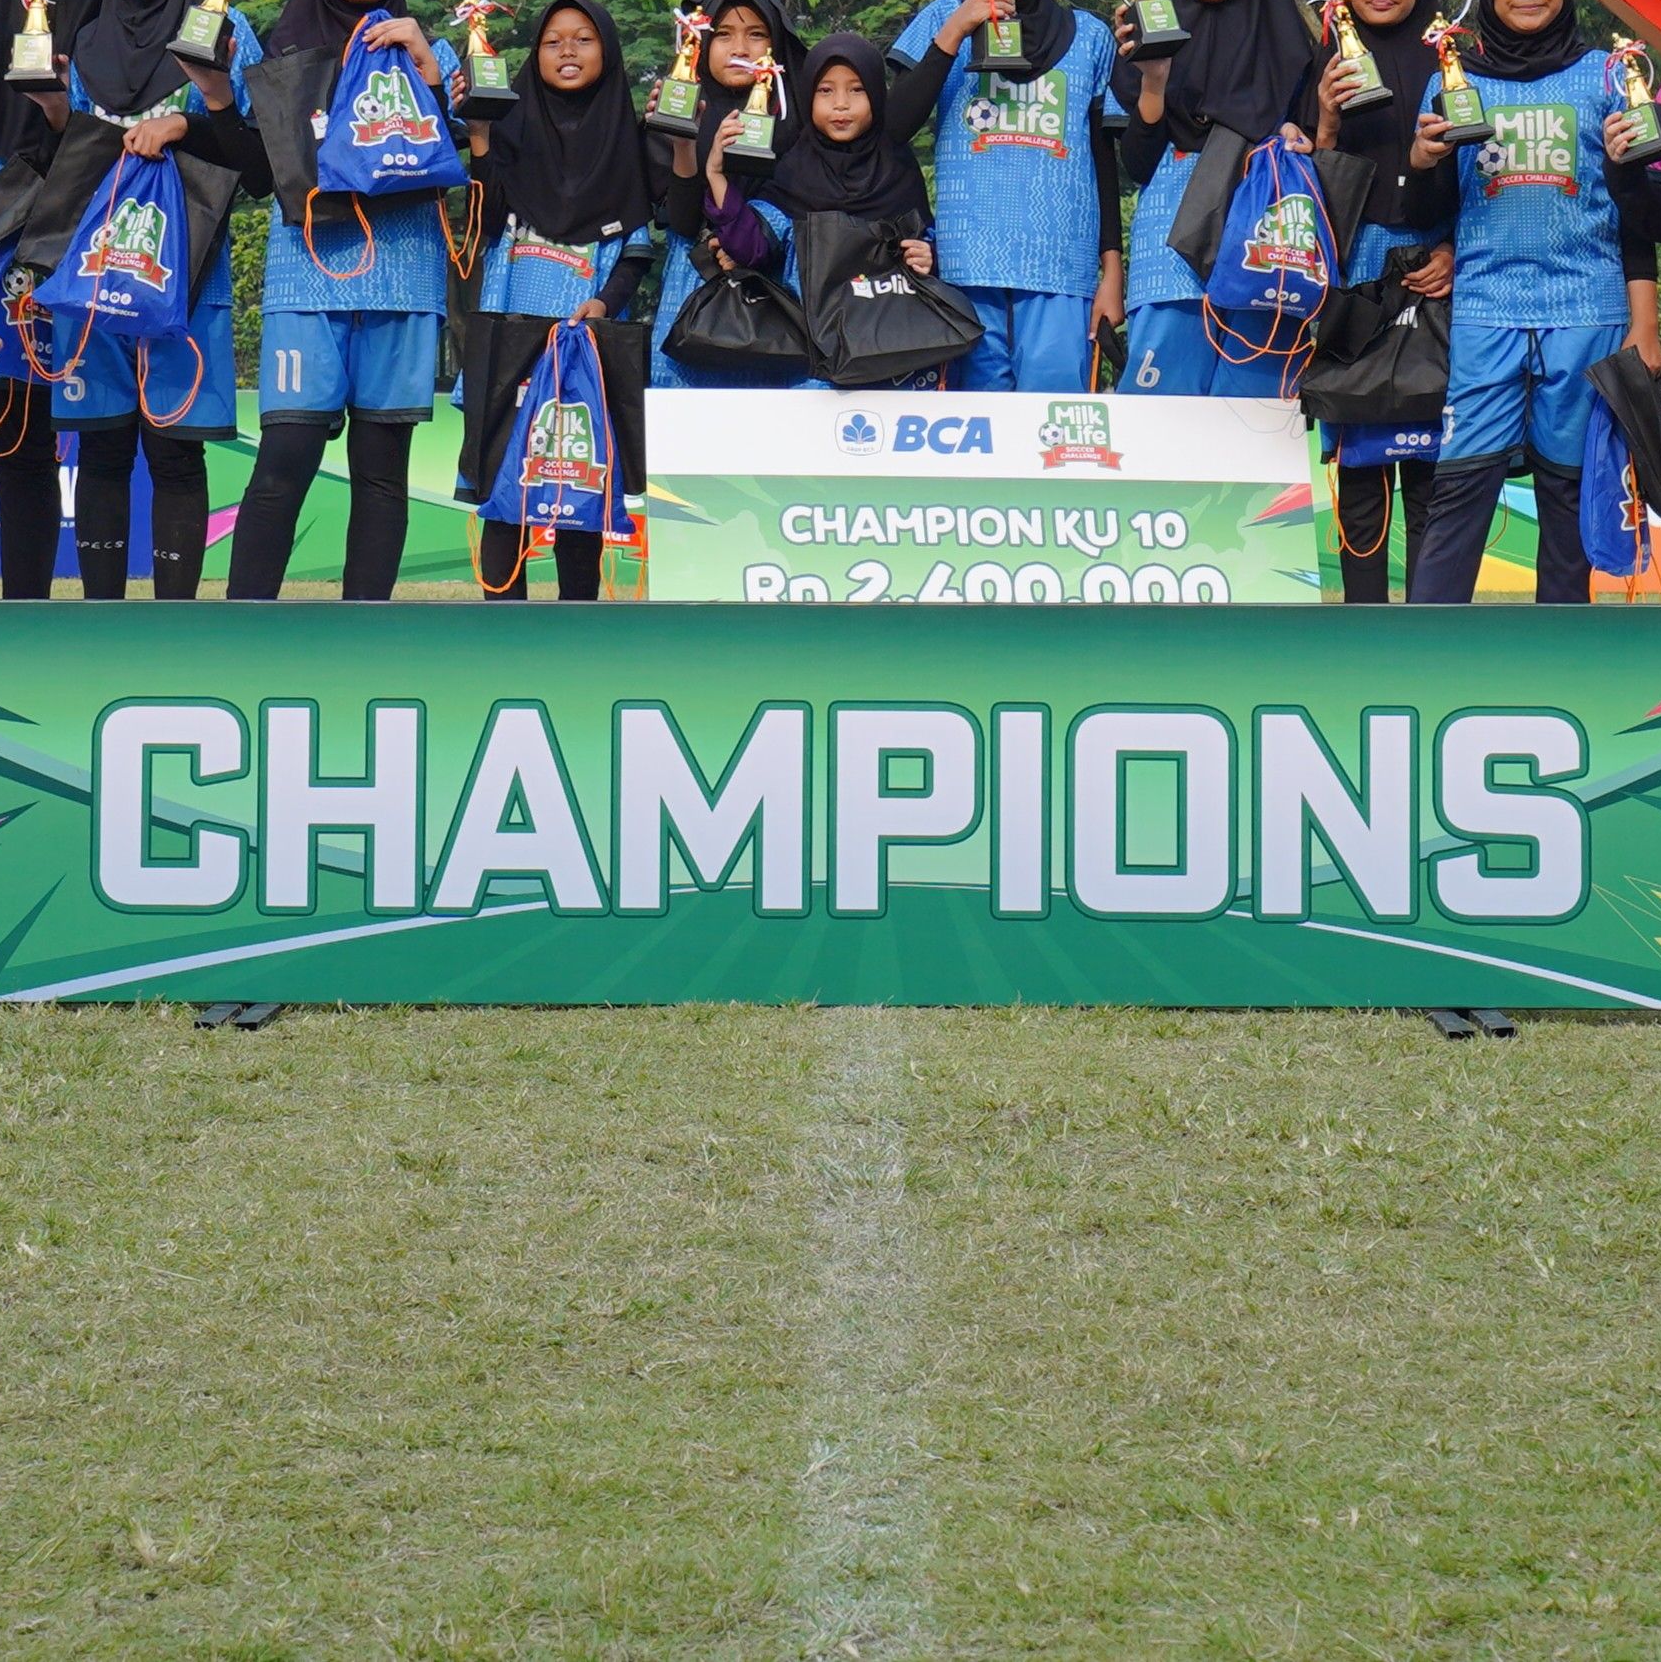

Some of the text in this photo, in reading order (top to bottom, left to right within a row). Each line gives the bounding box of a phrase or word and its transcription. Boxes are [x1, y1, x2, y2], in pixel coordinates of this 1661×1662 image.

[990, 72, 1058, 105] Milk
[999, 103, 1061, 135] Life
[1495, 109, 1569, 141] Milk
[1508, 140, 1571, 172] Life
[114, 228, 157, 256] Life
[275, 348, 302, 394] 11
[1136, 351, 1159, 389] 6
[1055, 404, 1104, 425] Milk
[892, 414, 993, 454] BCA
[1066, 422, 1107, 445] Life
[780, 504, 1189, 559] CHAMPION KU 10
[98, 703, 1584, 918] CHAMPIONS
